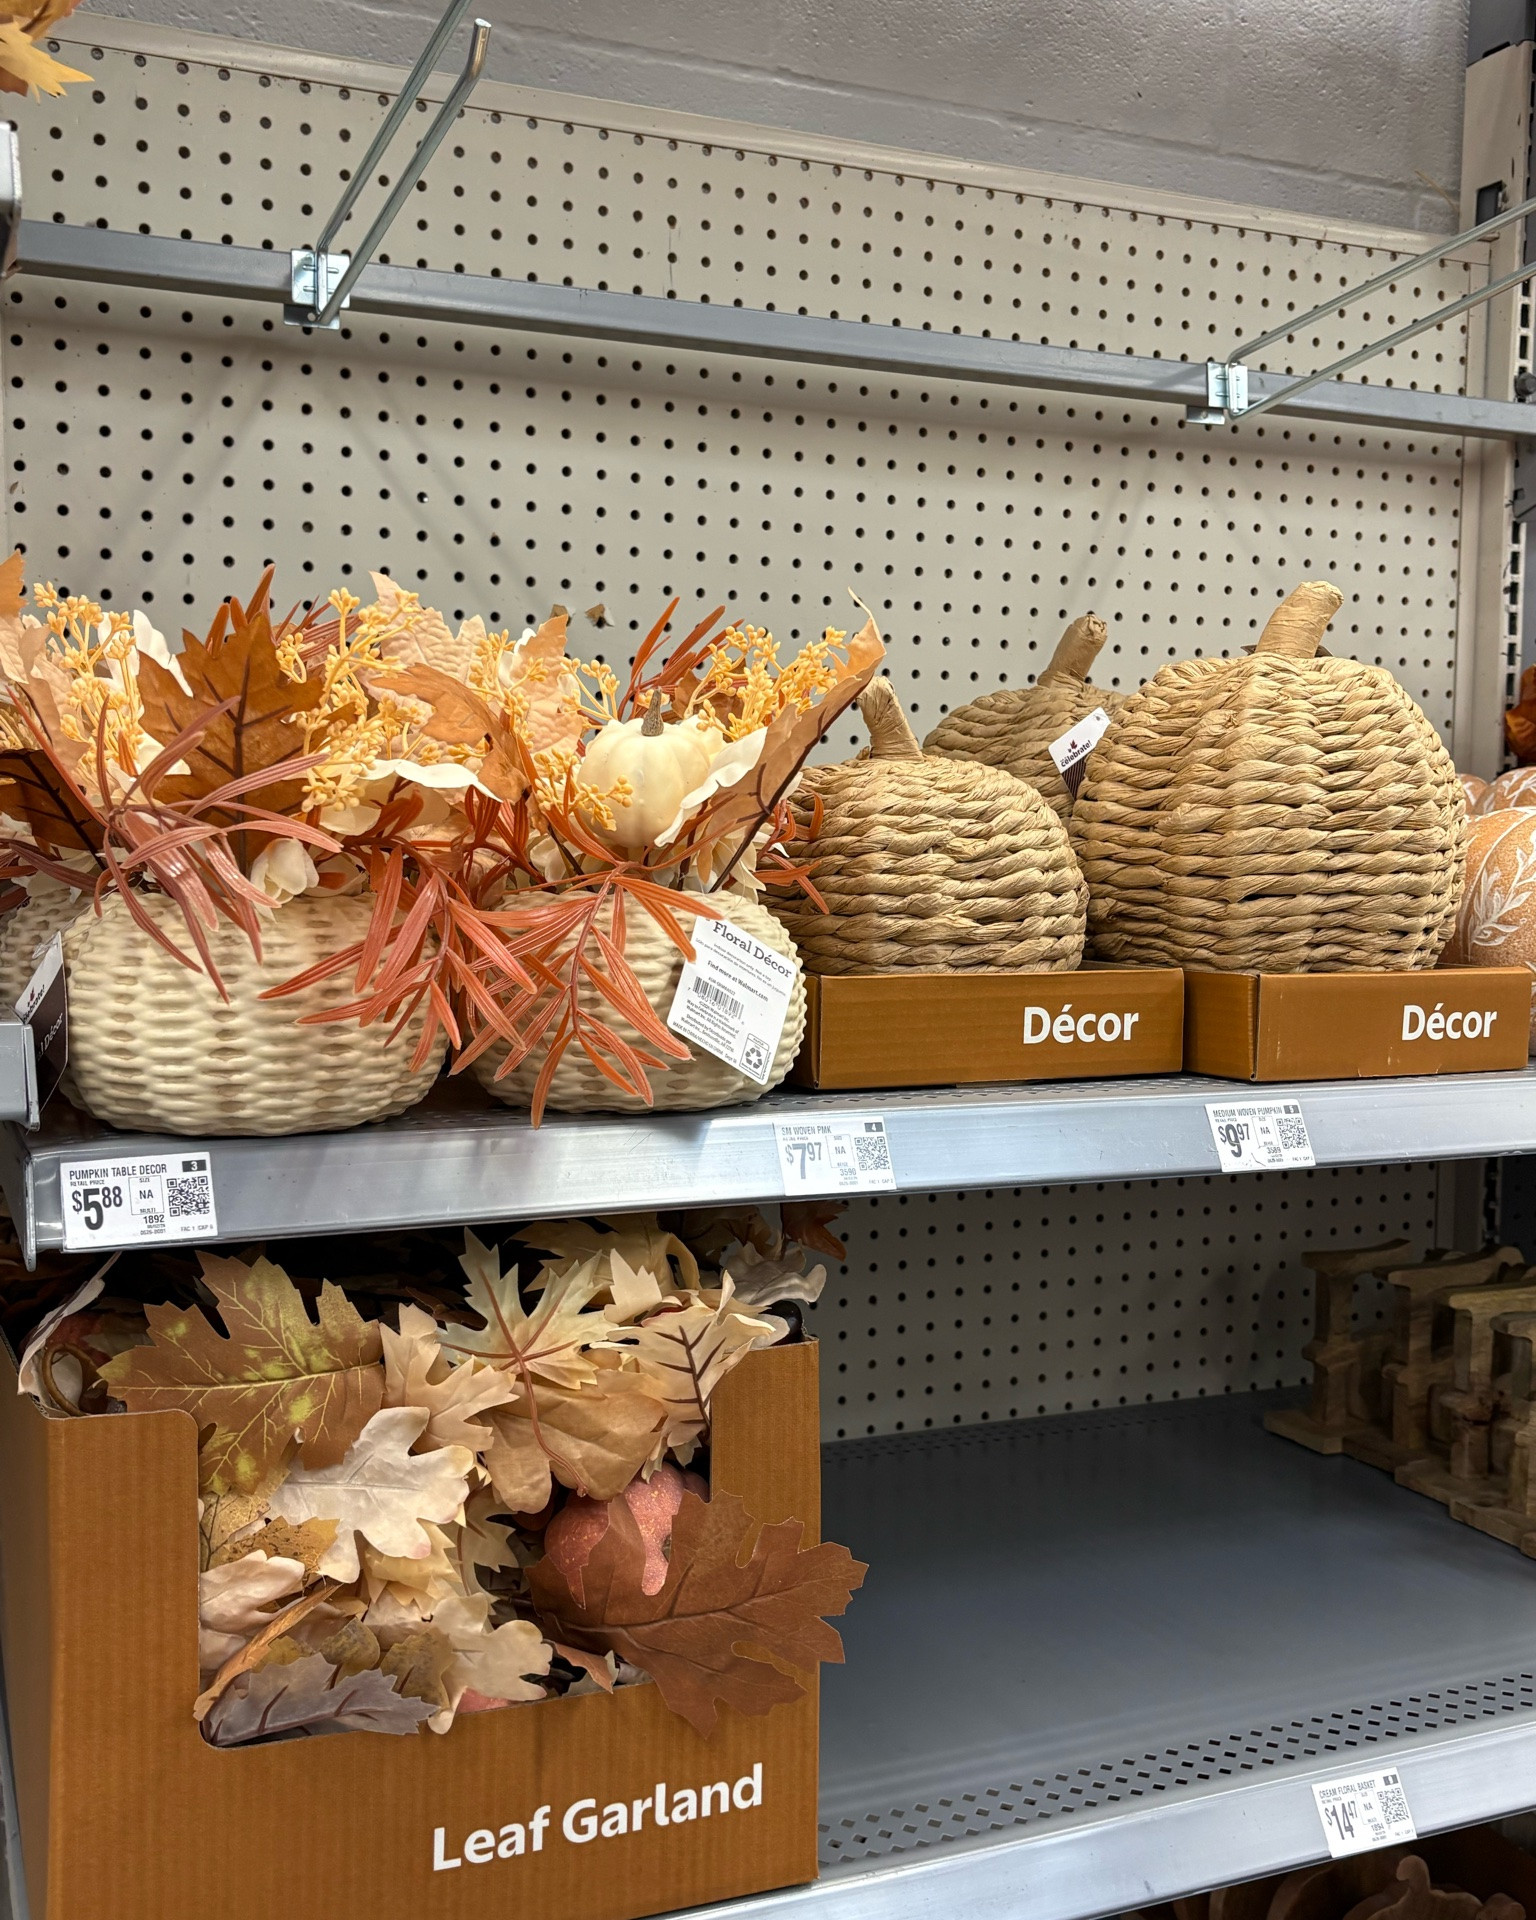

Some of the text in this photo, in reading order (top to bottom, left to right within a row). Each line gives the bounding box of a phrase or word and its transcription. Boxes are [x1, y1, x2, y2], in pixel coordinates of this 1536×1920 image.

[1061, 740, 1092, 767] celebrate!
[713, 921, 792, 978] Floral Décor
[708, 960, 719, 971] Find
[719, 968, 732, 979] more
[738, 979, 769, 1002] Walmart.com
[1023, 1004, 1140, 1044] Décor
[1401, 1003, 1497, 1041] Décor
[1213, 1107, 1282, 1118] MEDIUM WOVEN PUMPKIN
[781, 1125, 832, 1136] SM WOVEN PMK
[835, 1146, 846, 1154] NA
[191, 1161, 197, 1170] 3
[70, 1164, 167, 1180] PUMPKIN TABLE DECOR
[840, 1168, 857, 1176] 3590
[139, 1190, 154, 1199] NA
[144, 1215, 165, 1224] 1892
[1319, 1788, 1337, 1799] CREAM
[1338, 1784, 1357, 1795] FLORAL
[1357, 1780, 1376, 1791] BASKET
[1363, 1802, 1373, 1811] NA
[433, 1762, 763, 1871] Leaf Garland
[1371, 1823, 1384, 1832] 1894
